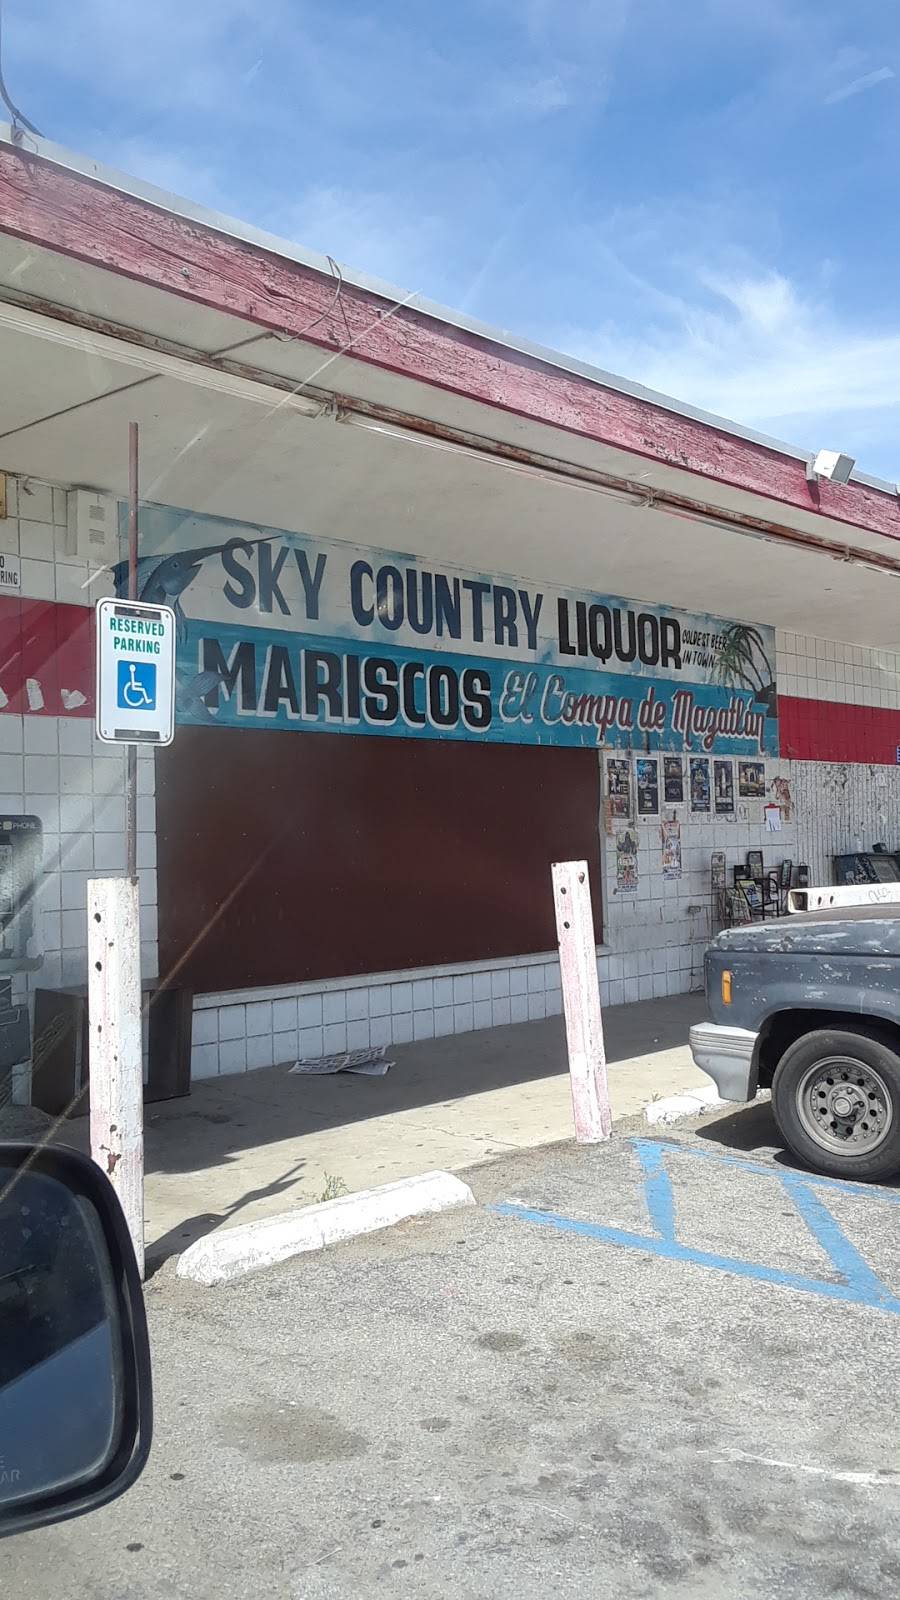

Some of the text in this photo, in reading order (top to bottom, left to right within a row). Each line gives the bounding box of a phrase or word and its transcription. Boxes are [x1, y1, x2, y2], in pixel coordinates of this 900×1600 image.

[221, 537, 682, 669] SKY COUNTRY LIQUOR
[110, 617, 165, 636] RESERVED
[114, 636, 161, 654] PARKING
[682, 629, 728, 651] COLDEST BEER
[682, 650, 716, 668] IN TOWN
[199, 638, 492, 733] MARISCOS
[499, 670, 538, 723] El
[541, 673, 634, 746] Compa
[637, 686, 666, 733] de
